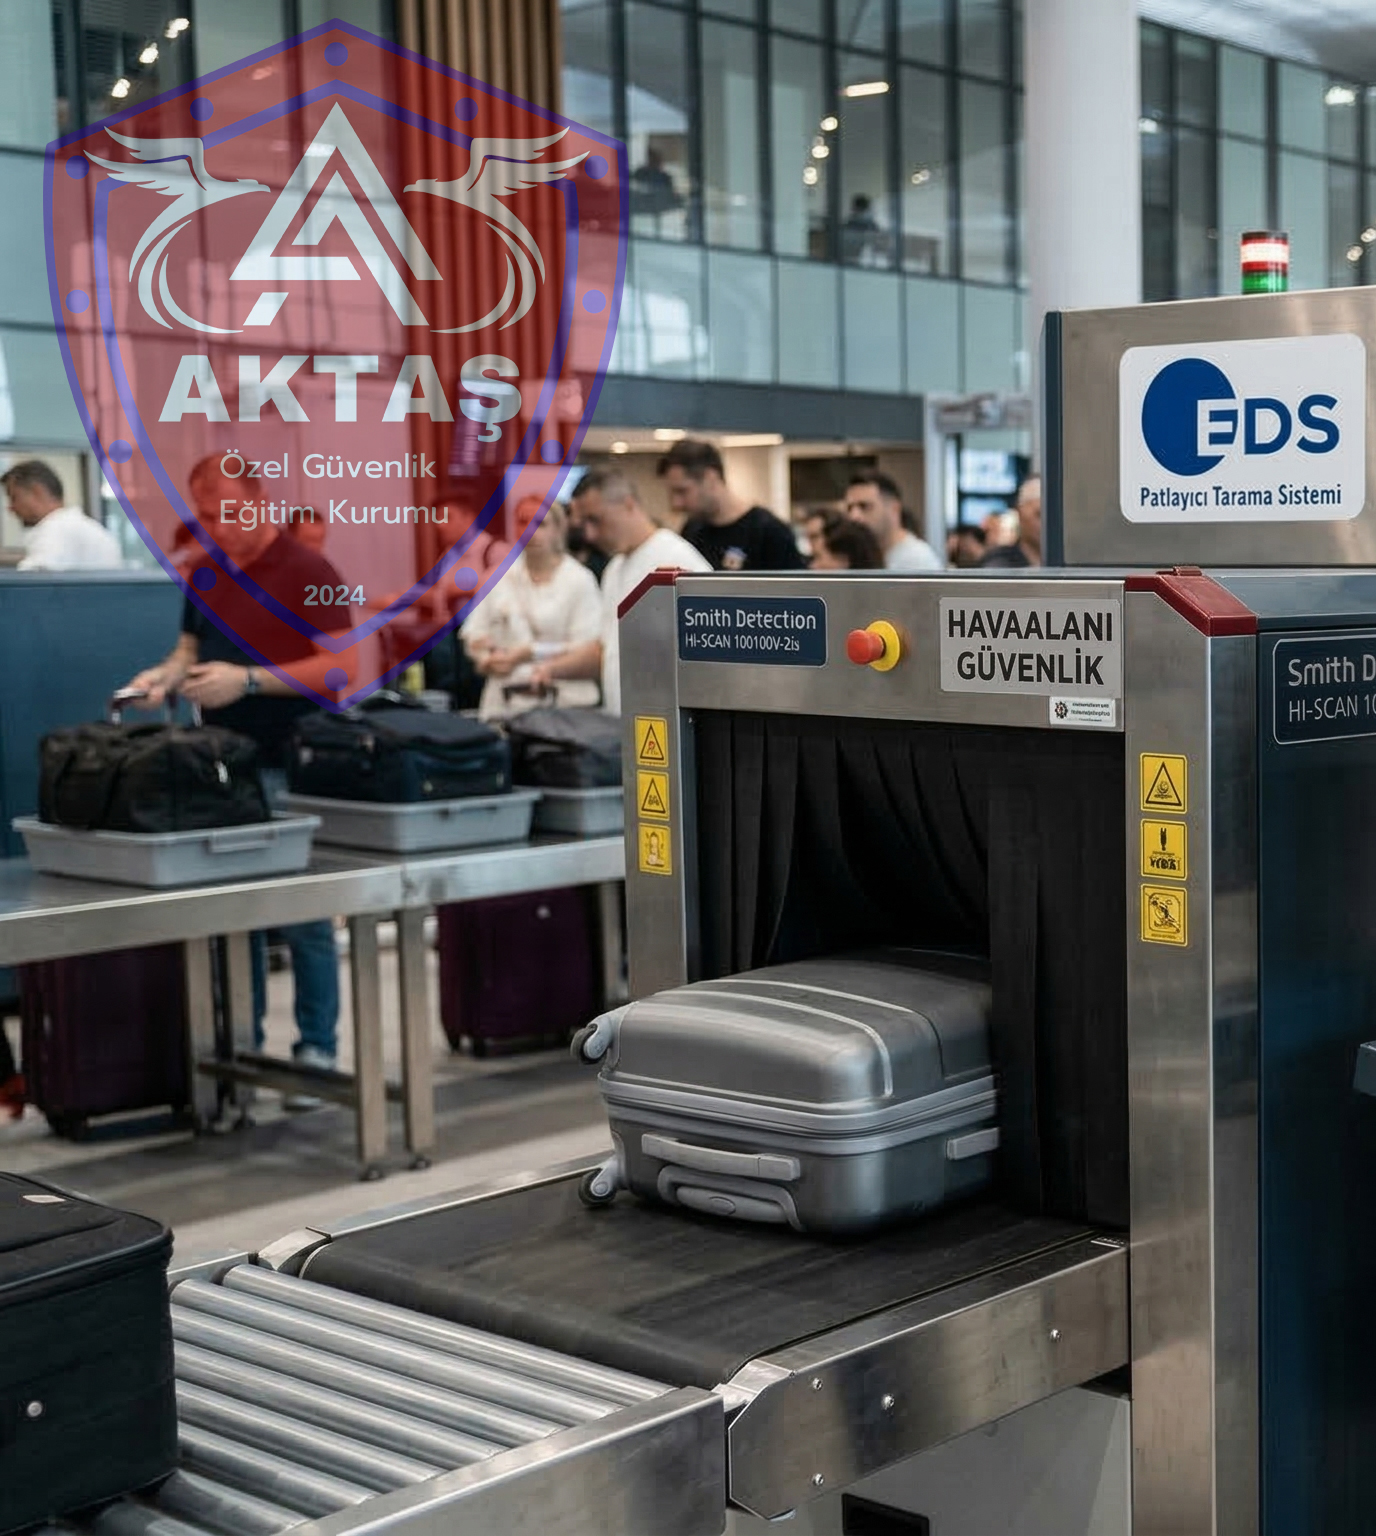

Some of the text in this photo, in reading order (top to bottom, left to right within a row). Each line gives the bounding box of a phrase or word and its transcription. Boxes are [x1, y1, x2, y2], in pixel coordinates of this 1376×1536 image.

[1197, 394, 1340, 457] EDS
[1140, 484, 1342, 511] Patlayıcı Tarama Sistemi
[684, 608, 817, 630] Smith Detection
[948, 609, 1113, 642] HAVAALANI
[685, 633, 800, 651] HI-SCAN 100100V-2is
[957, 645, 1105, 686] GÜVENLİK
[1288, 656, 1356, 686] Smith
[1289, 695, 1359, 722] HI-SCAN
